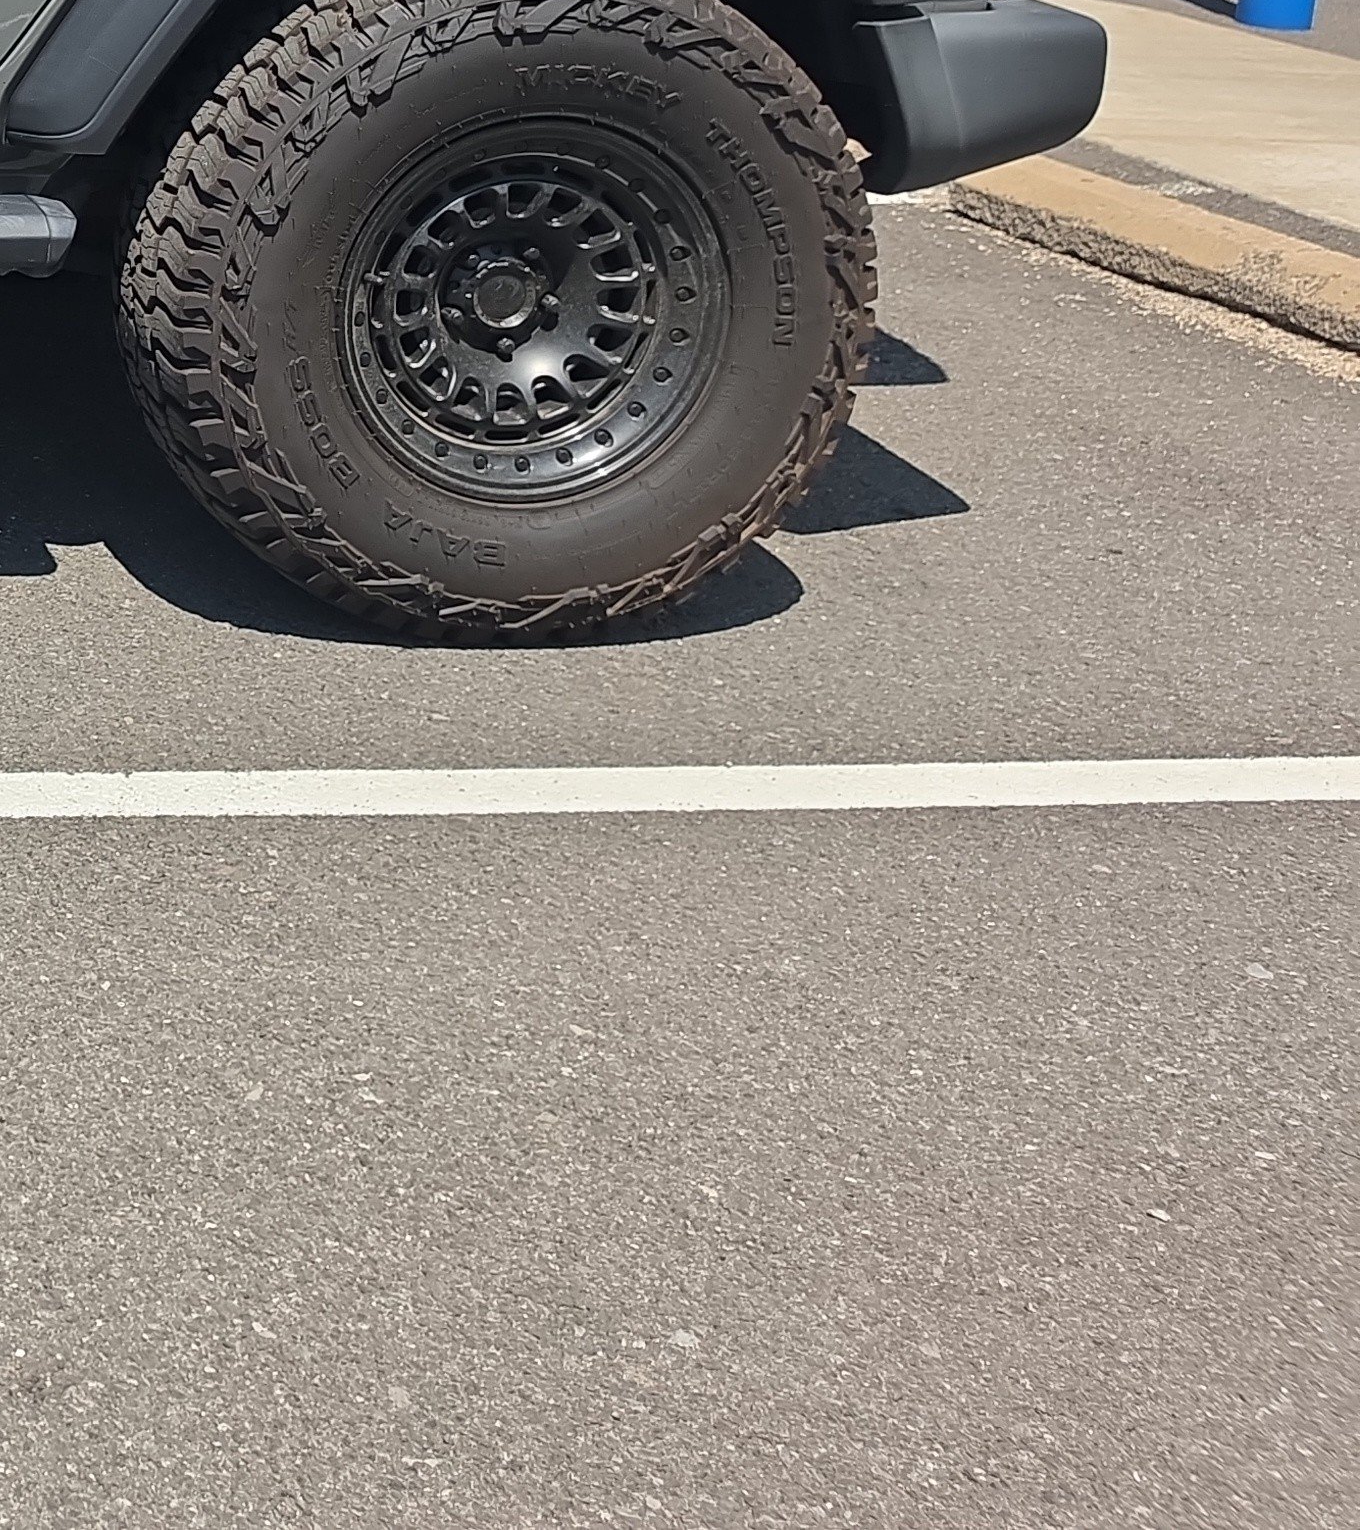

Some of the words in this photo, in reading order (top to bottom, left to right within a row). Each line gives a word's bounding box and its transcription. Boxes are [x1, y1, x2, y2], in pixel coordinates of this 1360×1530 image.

[706, 118, 796, 347] THOMPSON
[287, 356, 361, 489] BOSS
[384, 503, 507, 567] BAJA
